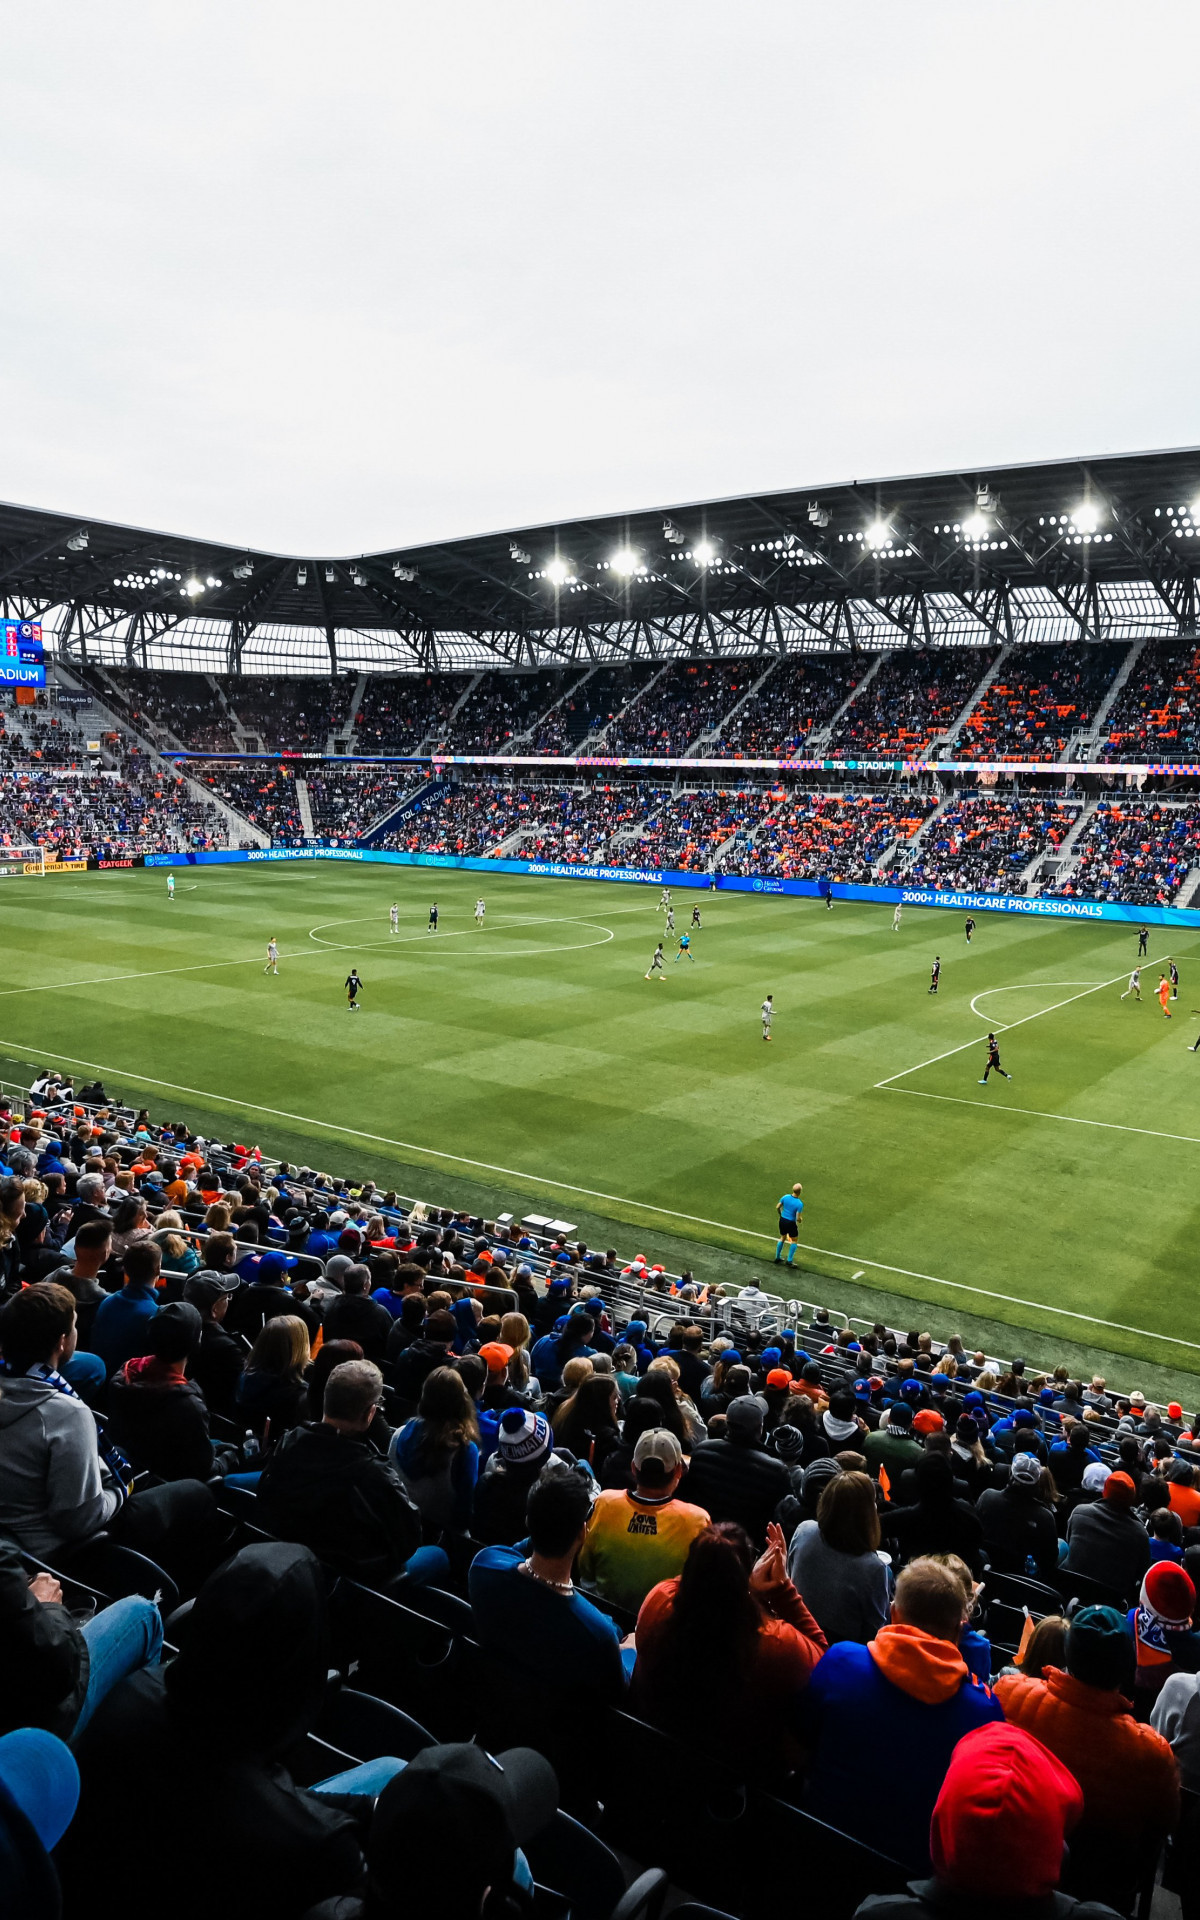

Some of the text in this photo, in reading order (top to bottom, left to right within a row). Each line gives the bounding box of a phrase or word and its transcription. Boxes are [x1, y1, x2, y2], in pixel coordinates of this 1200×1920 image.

[831, 761, 894, 770] TQL STADIUM
[400, 783, 451, 822] TQL STADIUM
[247, 848, 363, 860] 3000+ HEALTHCARE PROFESSIONALS
[98, 859, 133, 869] SEATGEEK
[528, 863, 662, 882] 3000+ HEALTHCARE PROFESSIONALS
[902, 891, 1103, 916] 3000+ HEALTHCARE PROFESSIONALS
